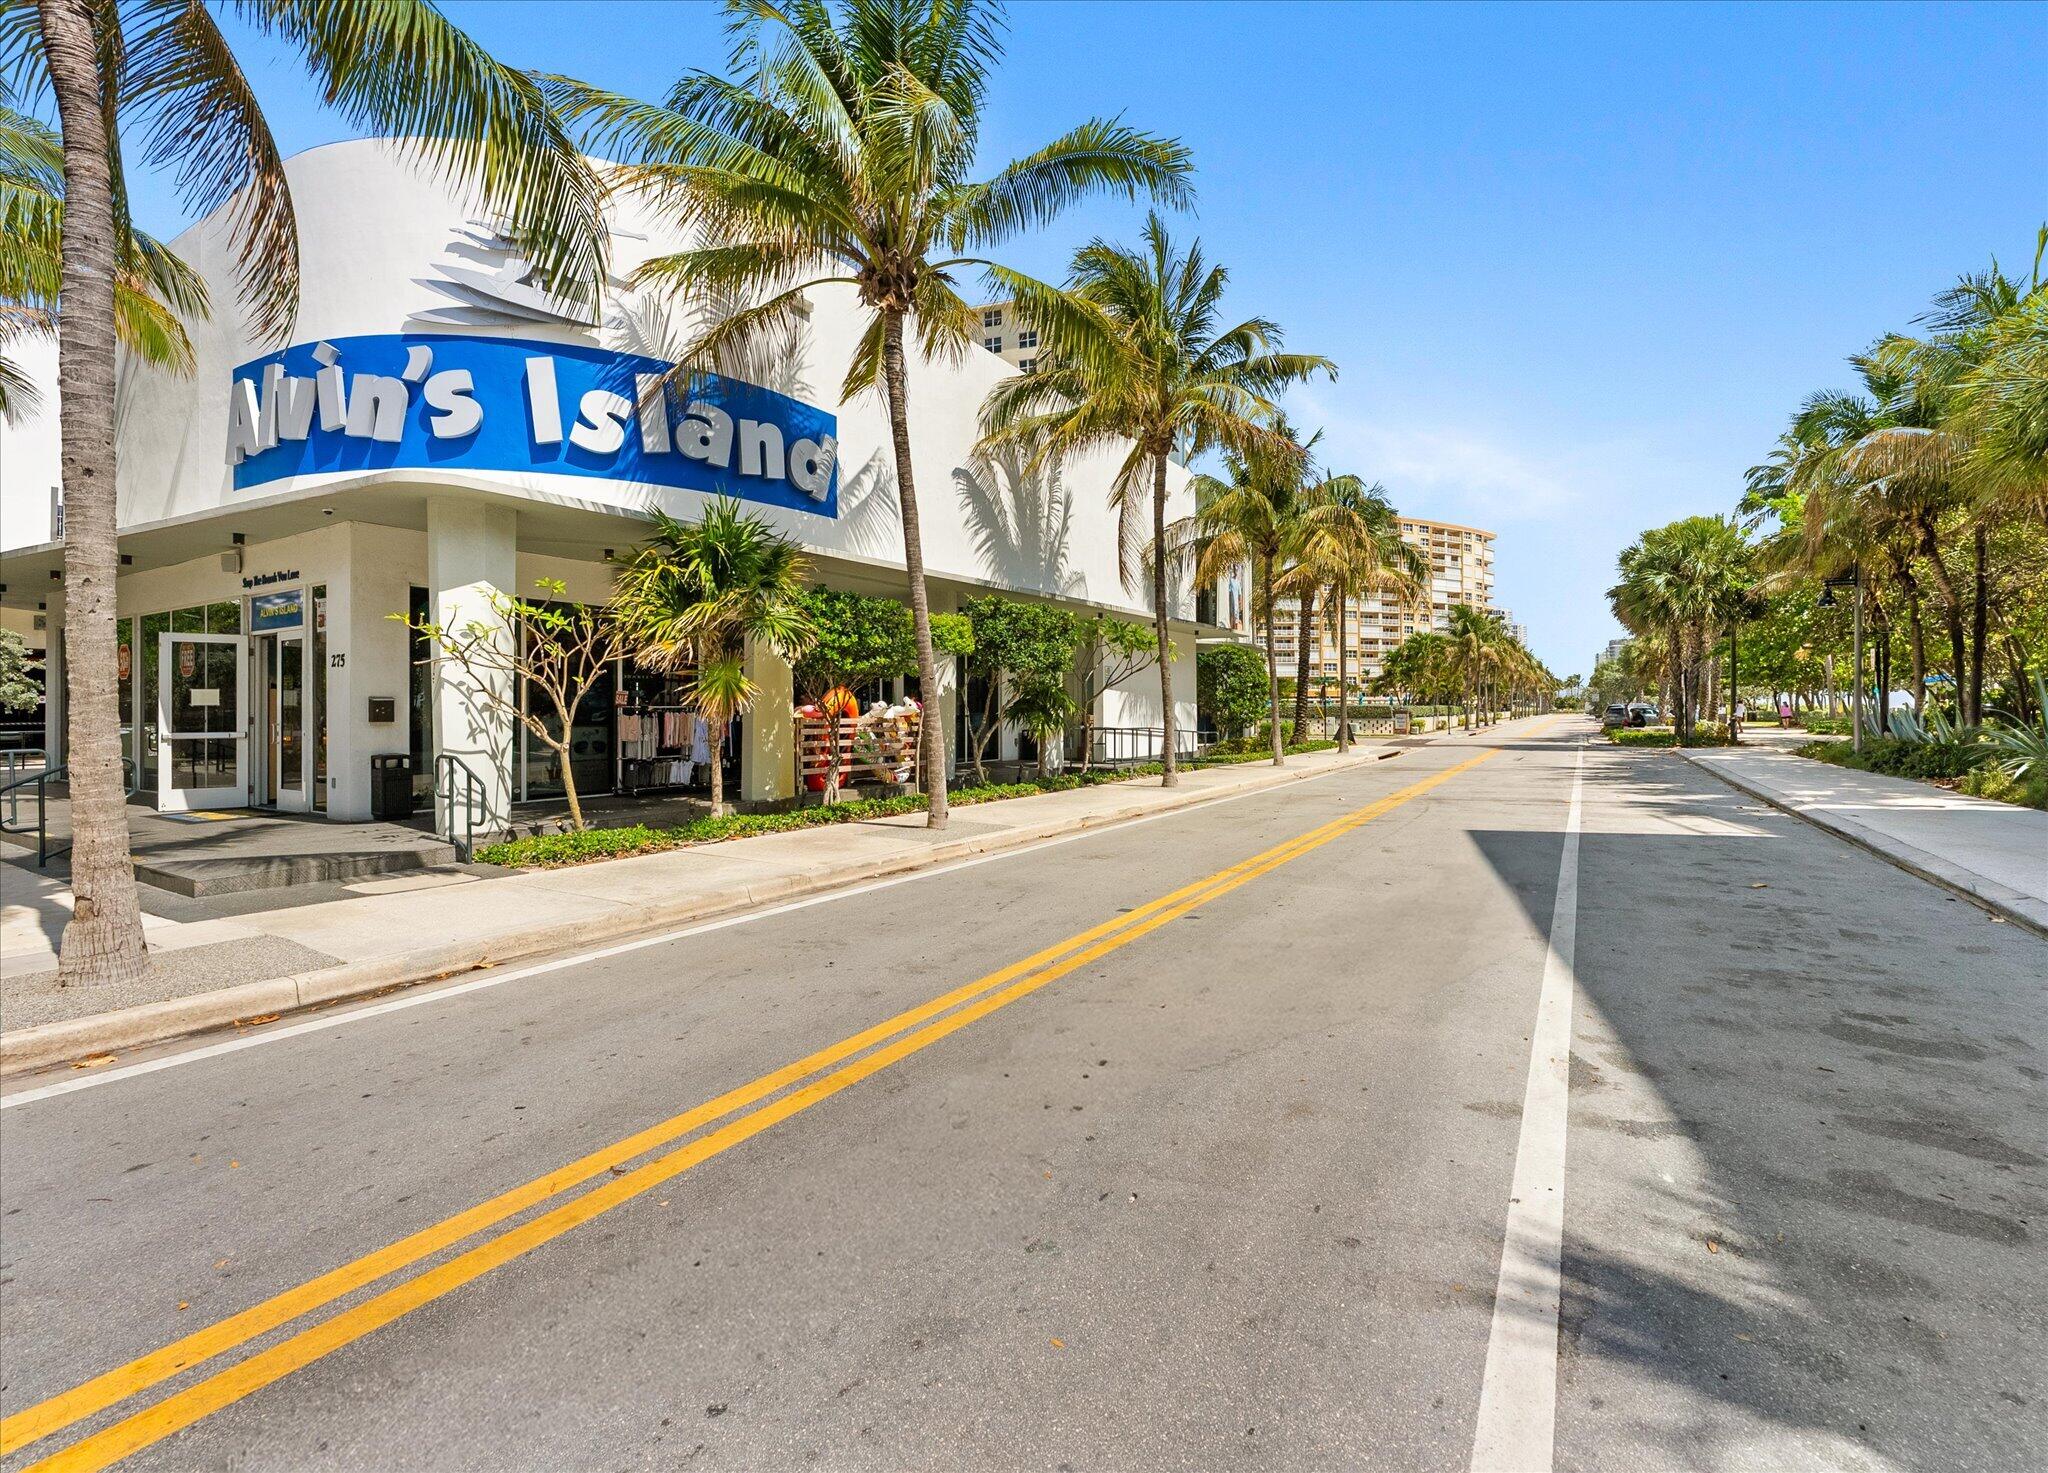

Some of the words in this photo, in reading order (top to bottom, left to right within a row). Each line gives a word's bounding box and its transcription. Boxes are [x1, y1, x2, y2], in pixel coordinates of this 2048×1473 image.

[225, 341, 484, 466] Alvin's
[526, 355, 839, 502] Island
[279, 602, 299, 616] ISLAND
[331, 653, 345, 667] 275
